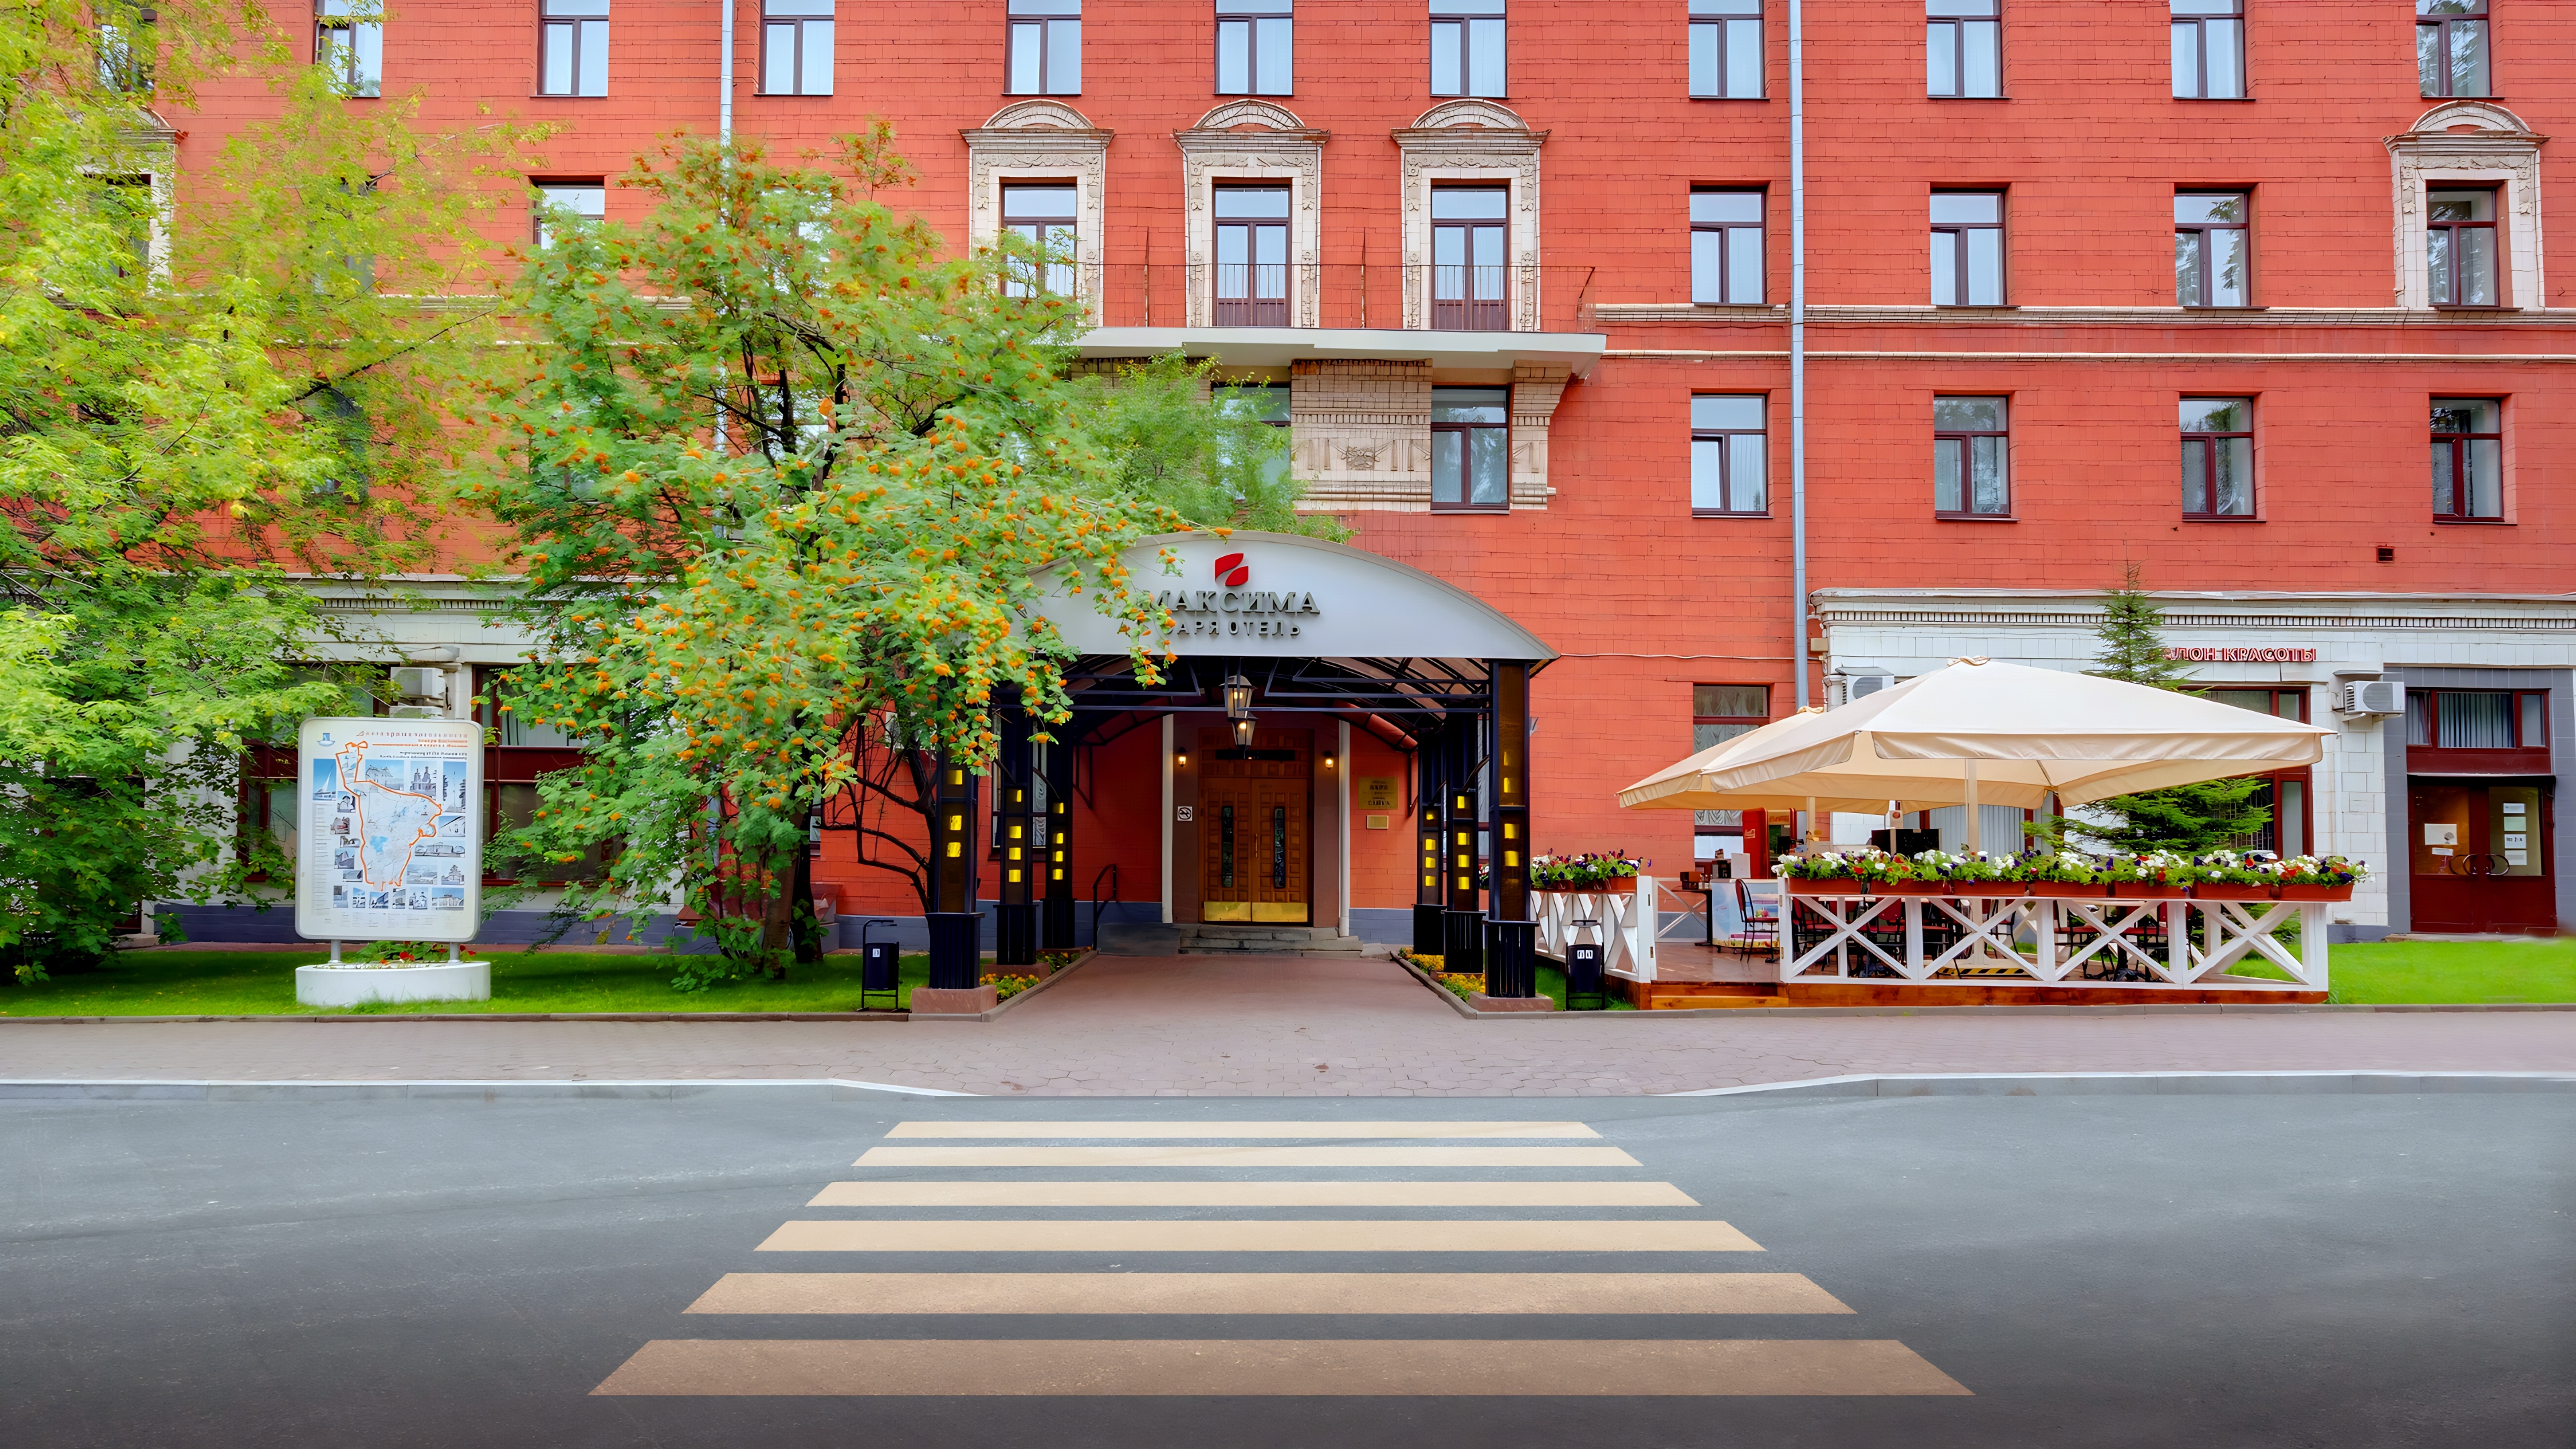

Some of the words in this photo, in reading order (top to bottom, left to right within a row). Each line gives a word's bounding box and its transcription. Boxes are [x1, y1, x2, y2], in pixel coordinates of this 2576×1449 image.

[1166, 619, 1220, 635] АРЯ
[1228, 620, 1301, 636] ОТЕЛЬ
[2222, 647, 2316, 662] КРАСОТЫ
